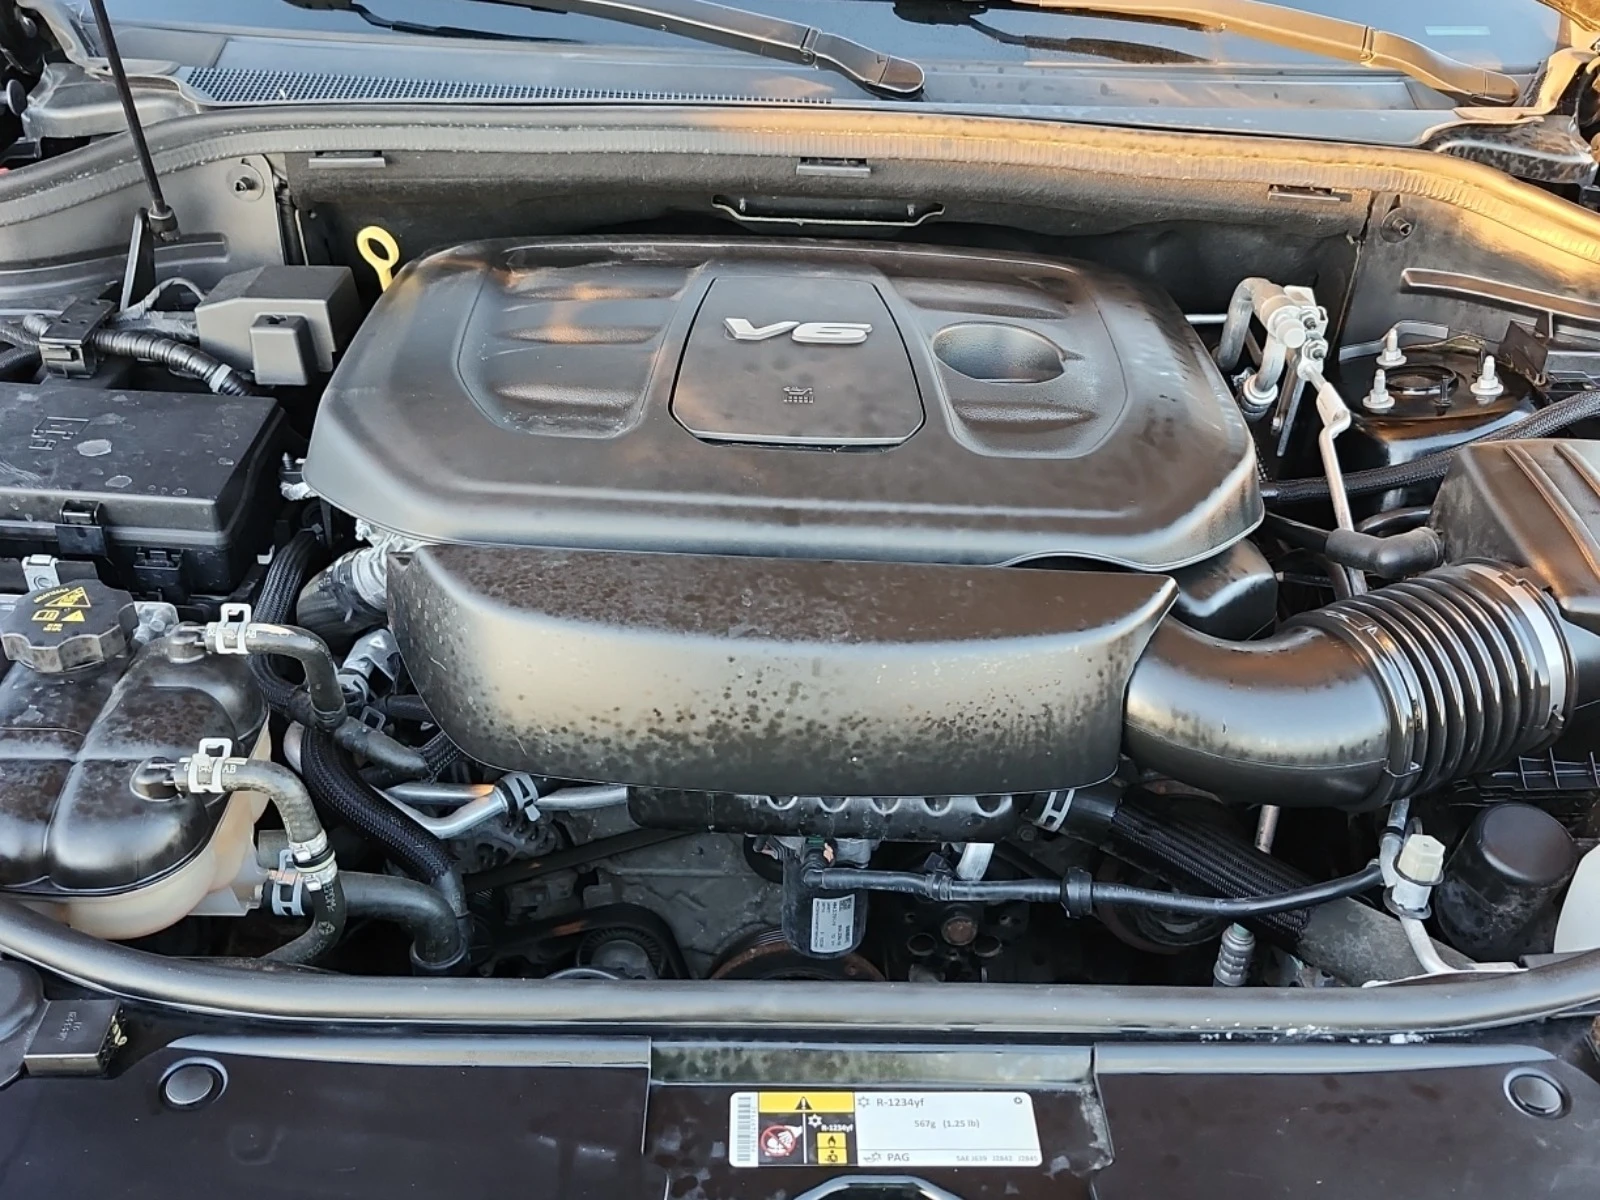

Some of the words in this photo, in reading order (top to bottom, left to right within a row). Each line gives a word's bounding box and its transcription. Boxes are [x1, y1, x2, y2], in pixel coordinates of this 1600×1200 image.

[723, 317, 873, 344] V6
[876, 1098, 924, 1109] R-1234yf
[914, 1119, 936, 1129] 567g
[942, 1119, 966, 1129] (1.25
[967, 1119, 980, 1129] lb)
[887, 1152, 910, 1162] PAG
